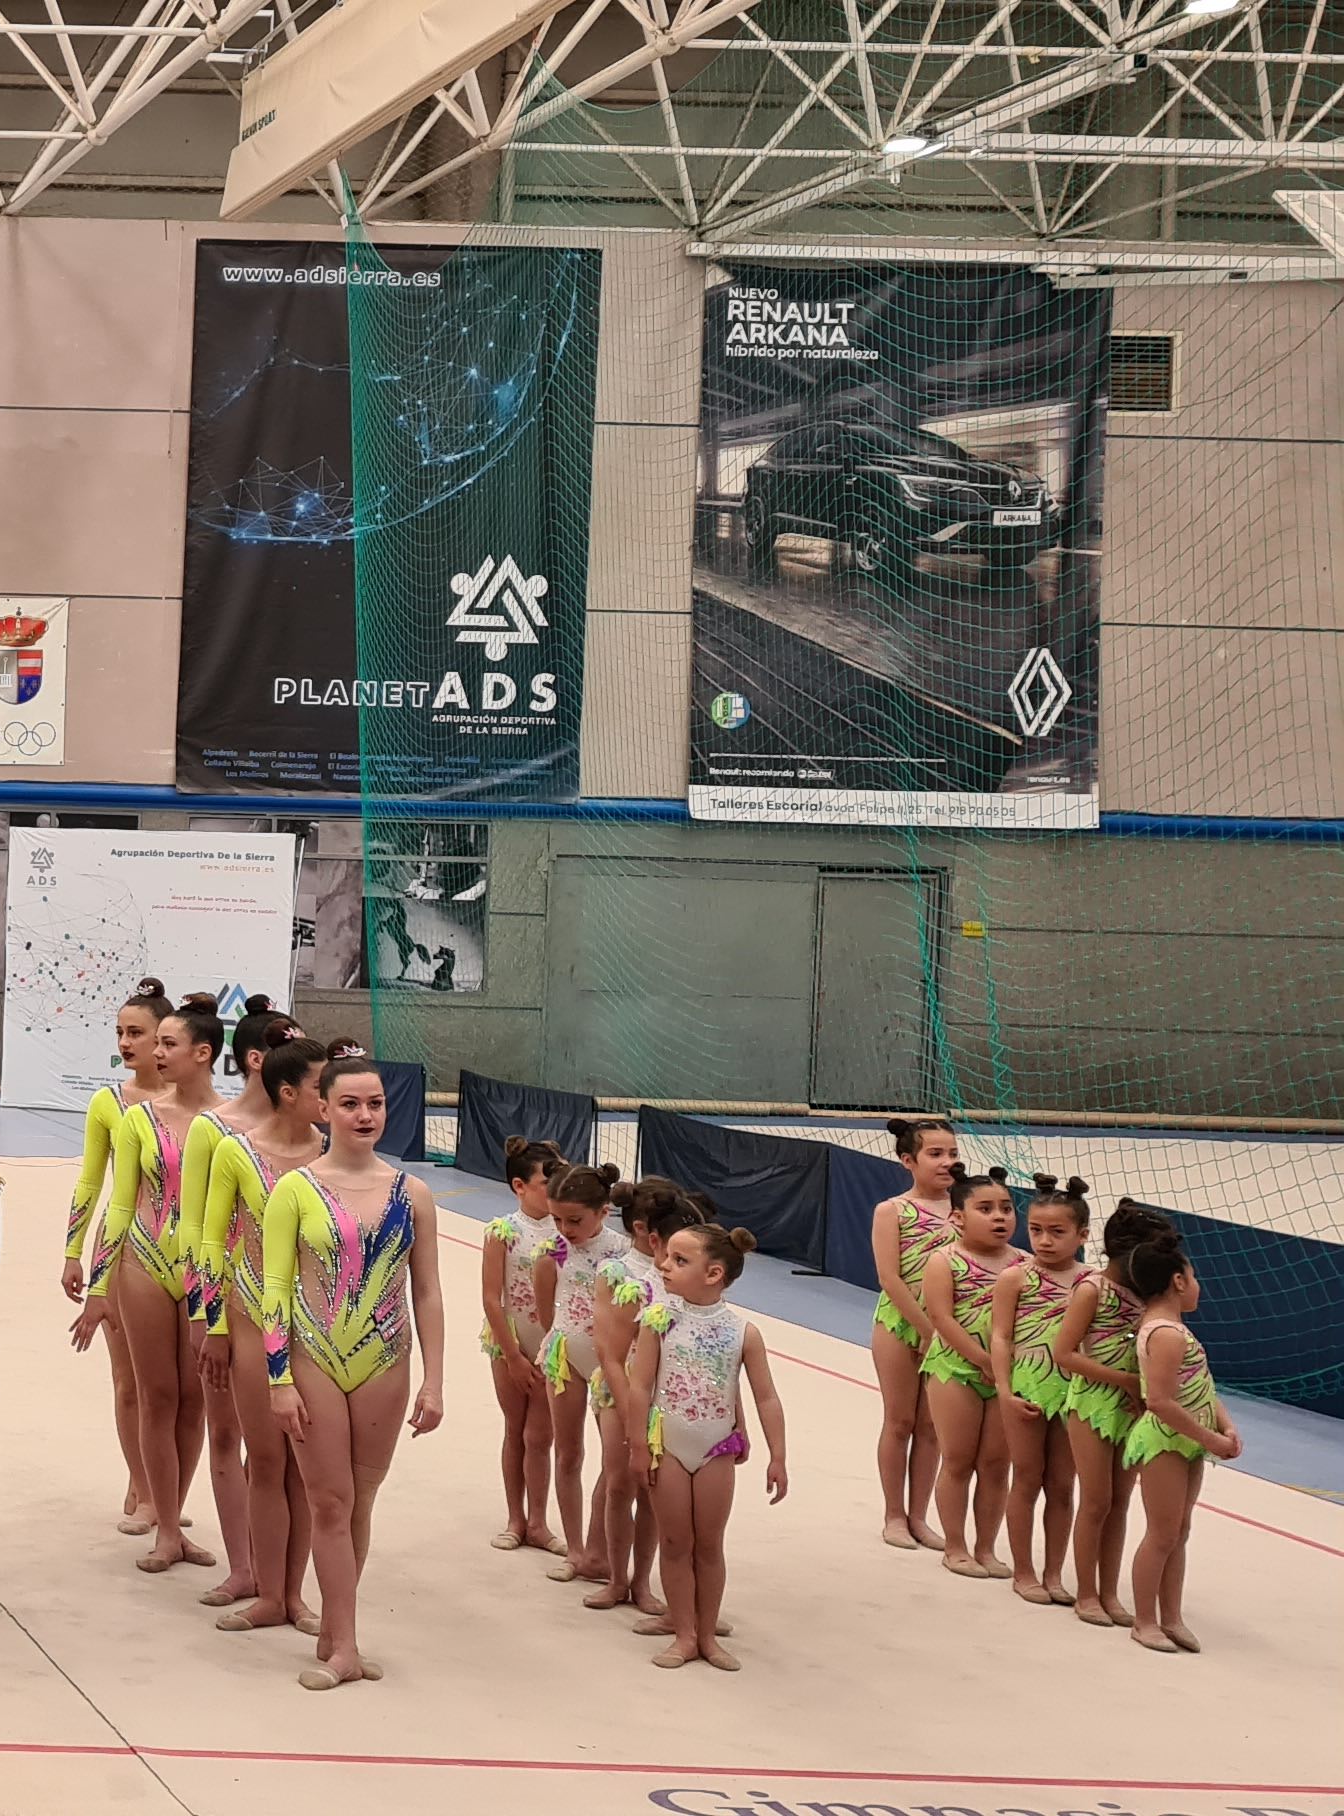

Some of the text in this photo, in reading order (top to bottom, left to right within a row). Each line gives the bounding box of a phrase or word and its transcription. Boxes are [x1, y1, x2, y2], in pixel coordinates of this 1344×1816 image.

[223, 266, 441, 287] www.adsierra.es
[728, 287, 779, 300] NUEVO
[727, 300, 855, 324] RENAULT
[726, 323, 850, 346] ARKANA
[725, 345, 879, 360] híbrido por naturaleza
[431, 714, 557, 726] AGRUPACIÓN DEPORTIVA
[459, 726, 528, 735] DE LA SIERRA
[710, 798, 763, 810] Talleres
[766, 799, 823, 812] Escorial
[111, 848, 275, 862] Agrupación Deportiva De la Sierra
[26, 875, 57, 886] ADS
